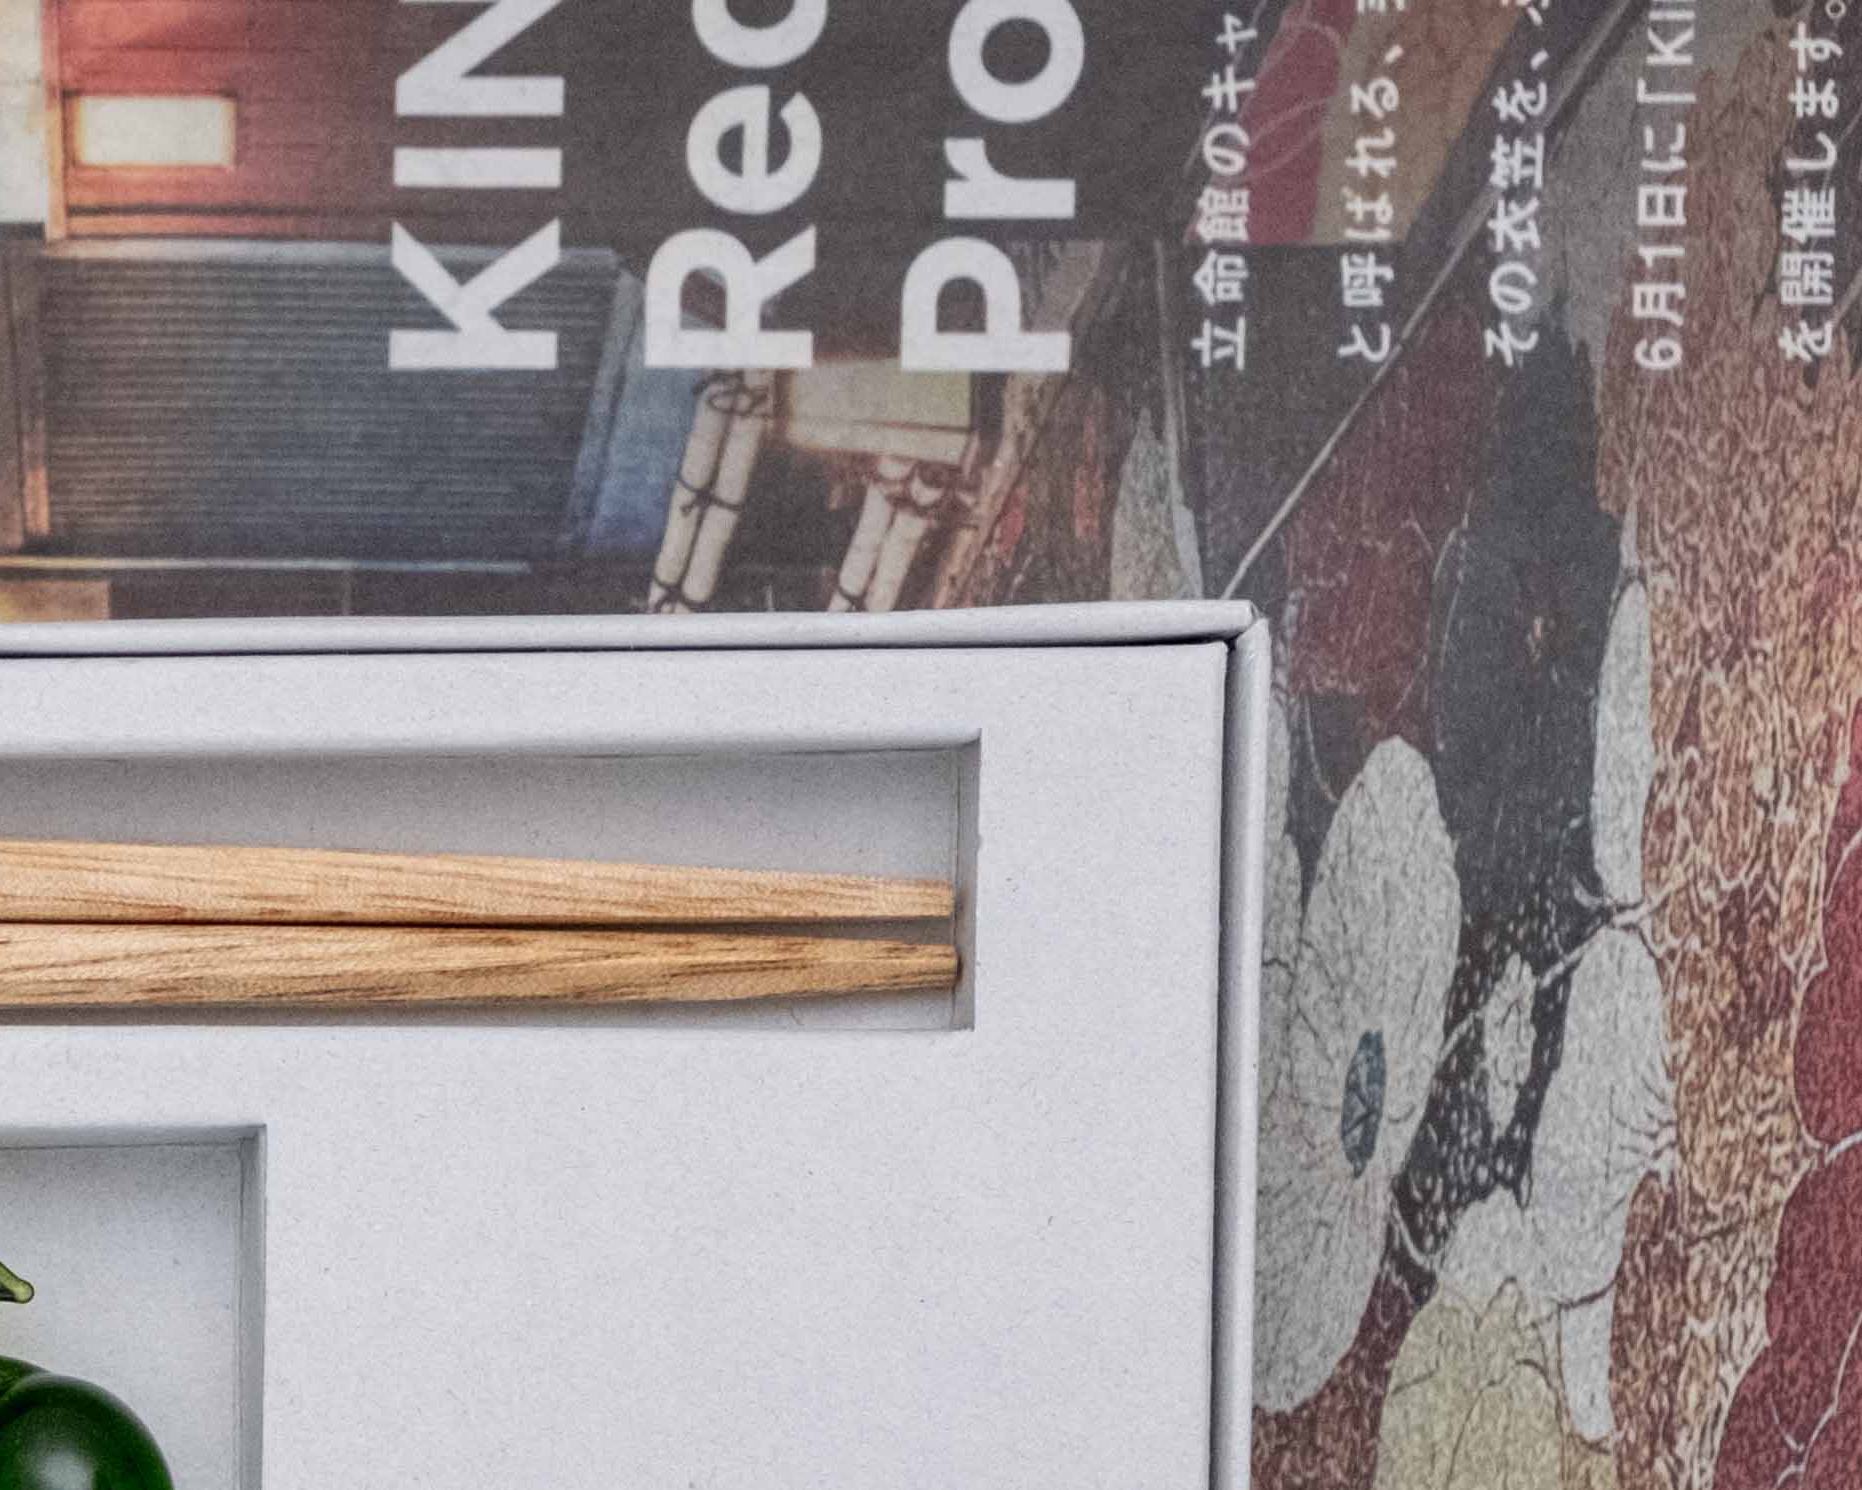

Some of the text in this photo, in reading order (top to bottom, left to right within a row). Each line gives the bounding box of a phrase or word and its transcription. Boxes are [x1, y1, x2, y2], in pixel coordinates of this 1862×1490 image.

[388, 0, 565, 371] KIN
[900, 0, 1086, 374] Pro
[1190, 13, 1257, 371] 立命館のキャ
[1337, 0, 1405, 364] と呼ばれる、
[1632, 0, 1697, 370] 6月1日に「KI
[1777, 0, 1849, 362] を開催します。
